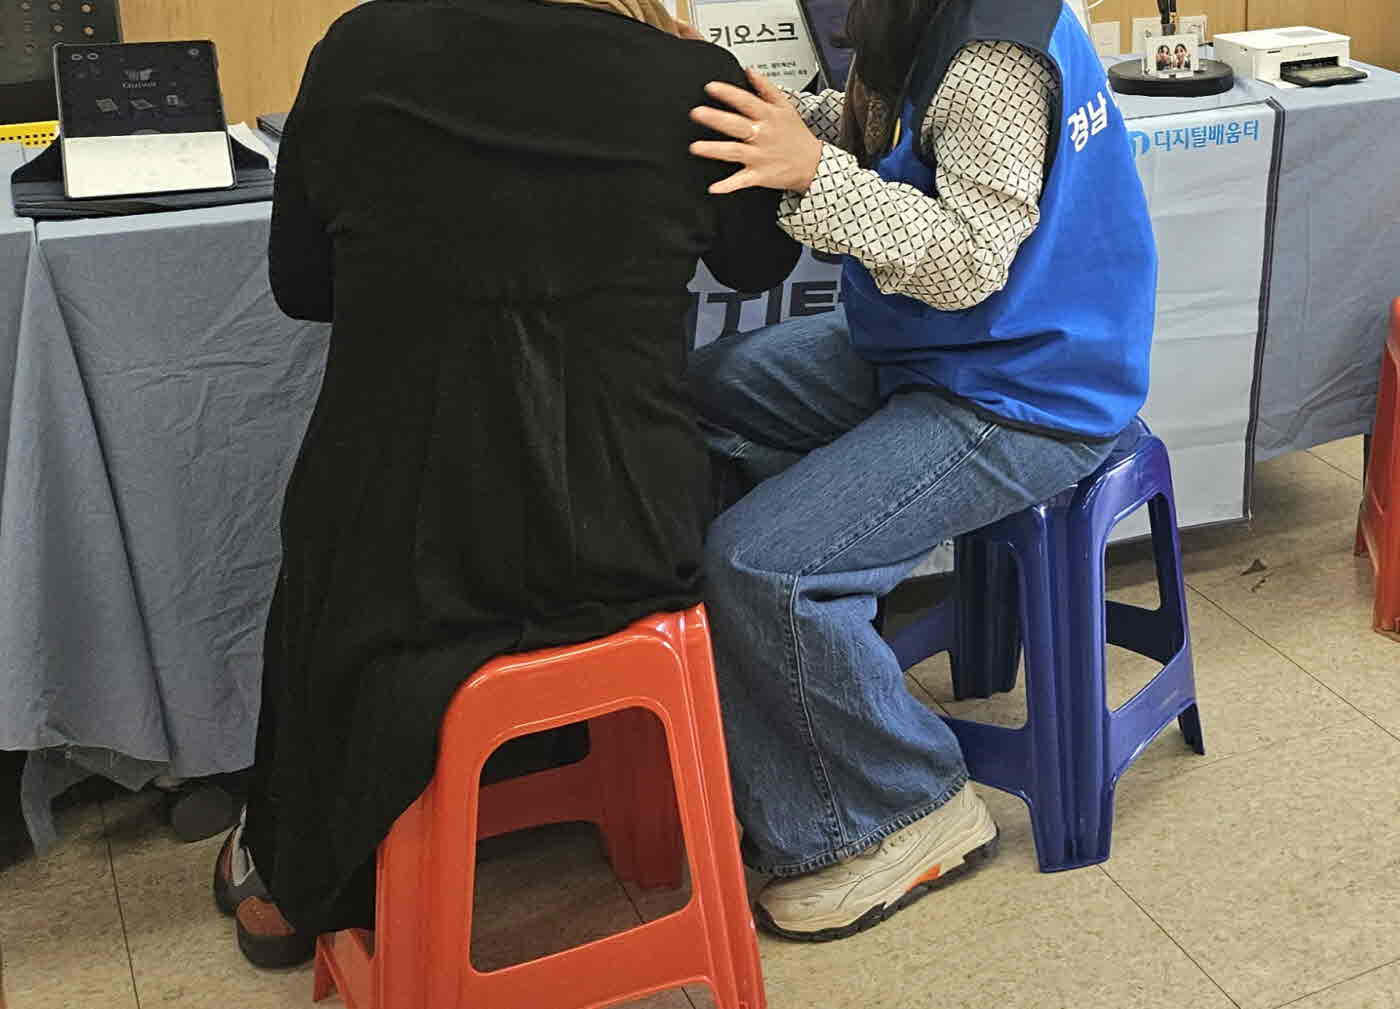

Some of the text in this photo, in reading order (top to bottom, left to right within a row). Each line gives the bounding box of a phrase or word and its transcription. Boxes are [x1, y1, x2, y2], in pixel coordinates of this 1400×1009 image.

[709, 22, 799, 47] 키오스크
[1067, 91, 1108, 152] 경남
[1154, 119, 1260, 152] 디지털배움터
